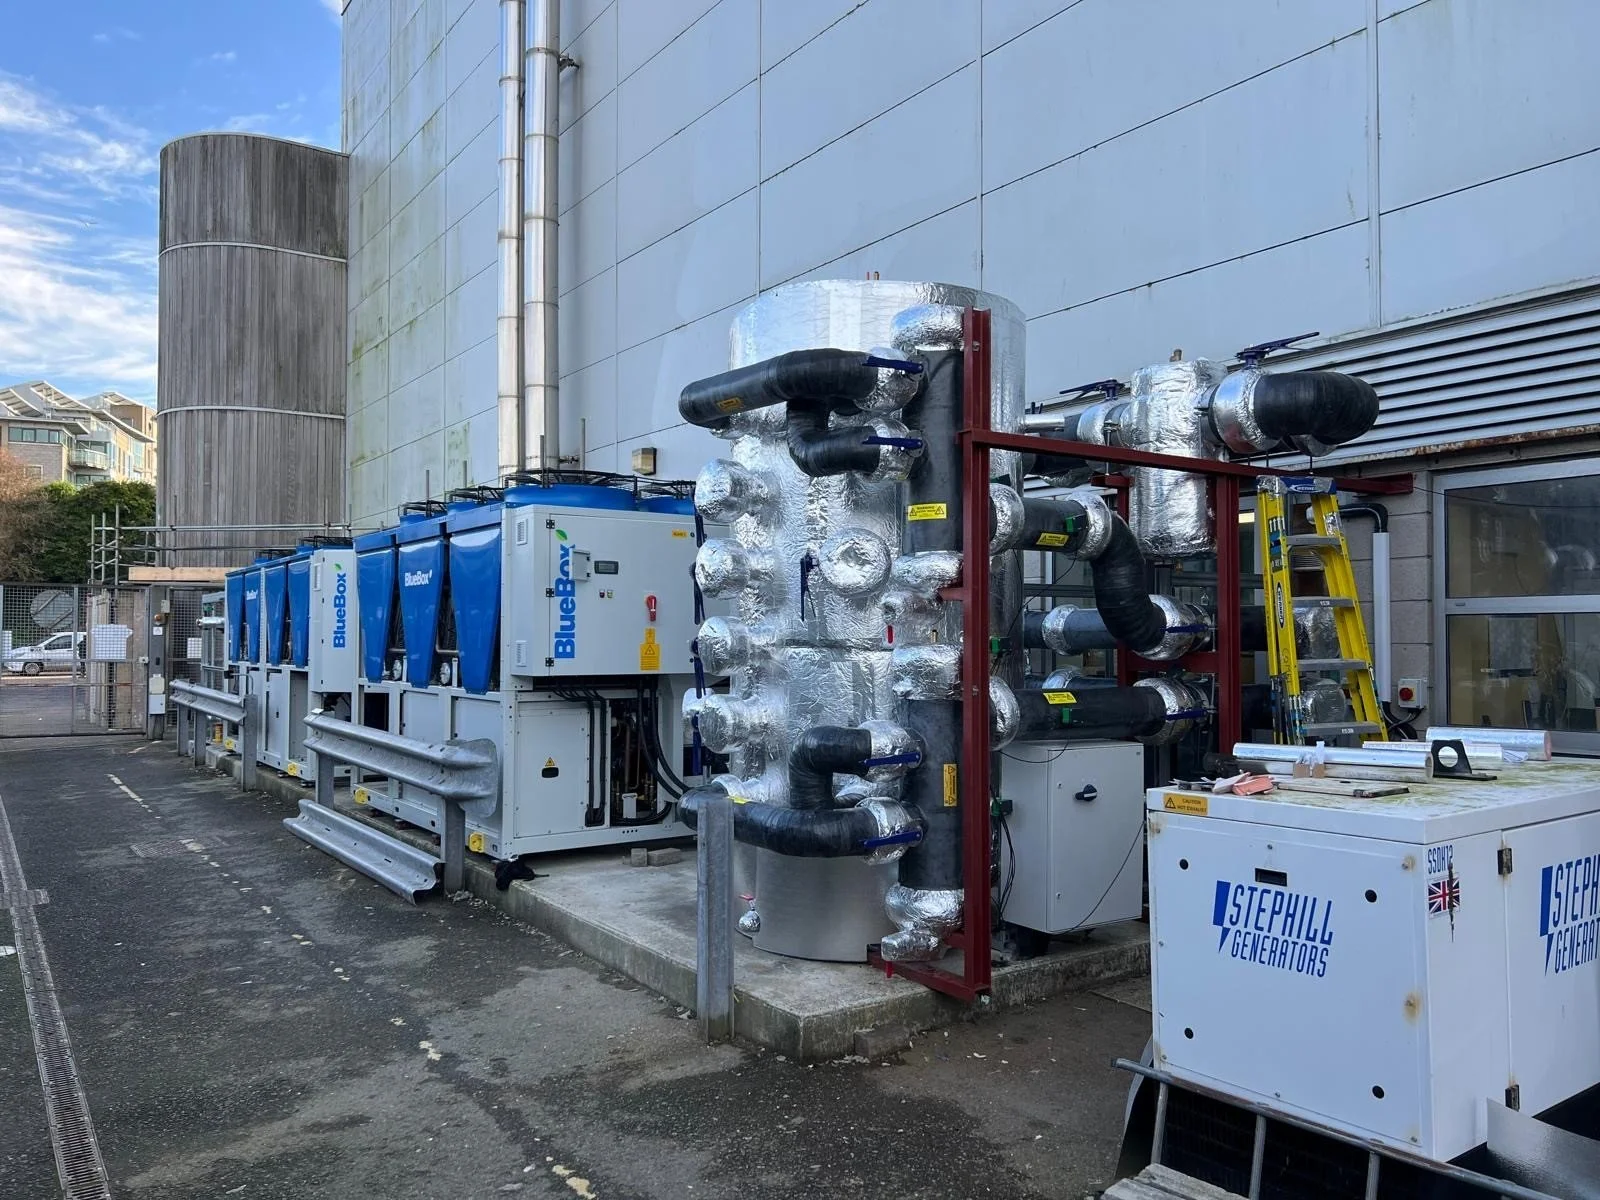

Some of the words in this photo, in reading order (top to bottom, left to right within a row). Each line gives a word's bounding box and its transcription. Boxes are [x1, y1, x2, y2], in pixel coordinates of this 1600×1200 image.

[404, 571, 429, 587] BlueBox
[554, 543, 576, 659] BlueBox
[333, 573, 347, 648] BlueBox
[1428, 844, 1453, 874] SSDH12
[1229, 884, 1334, 945] STEPHILL
[1231, 929, 1329, 977] GENERATORS
